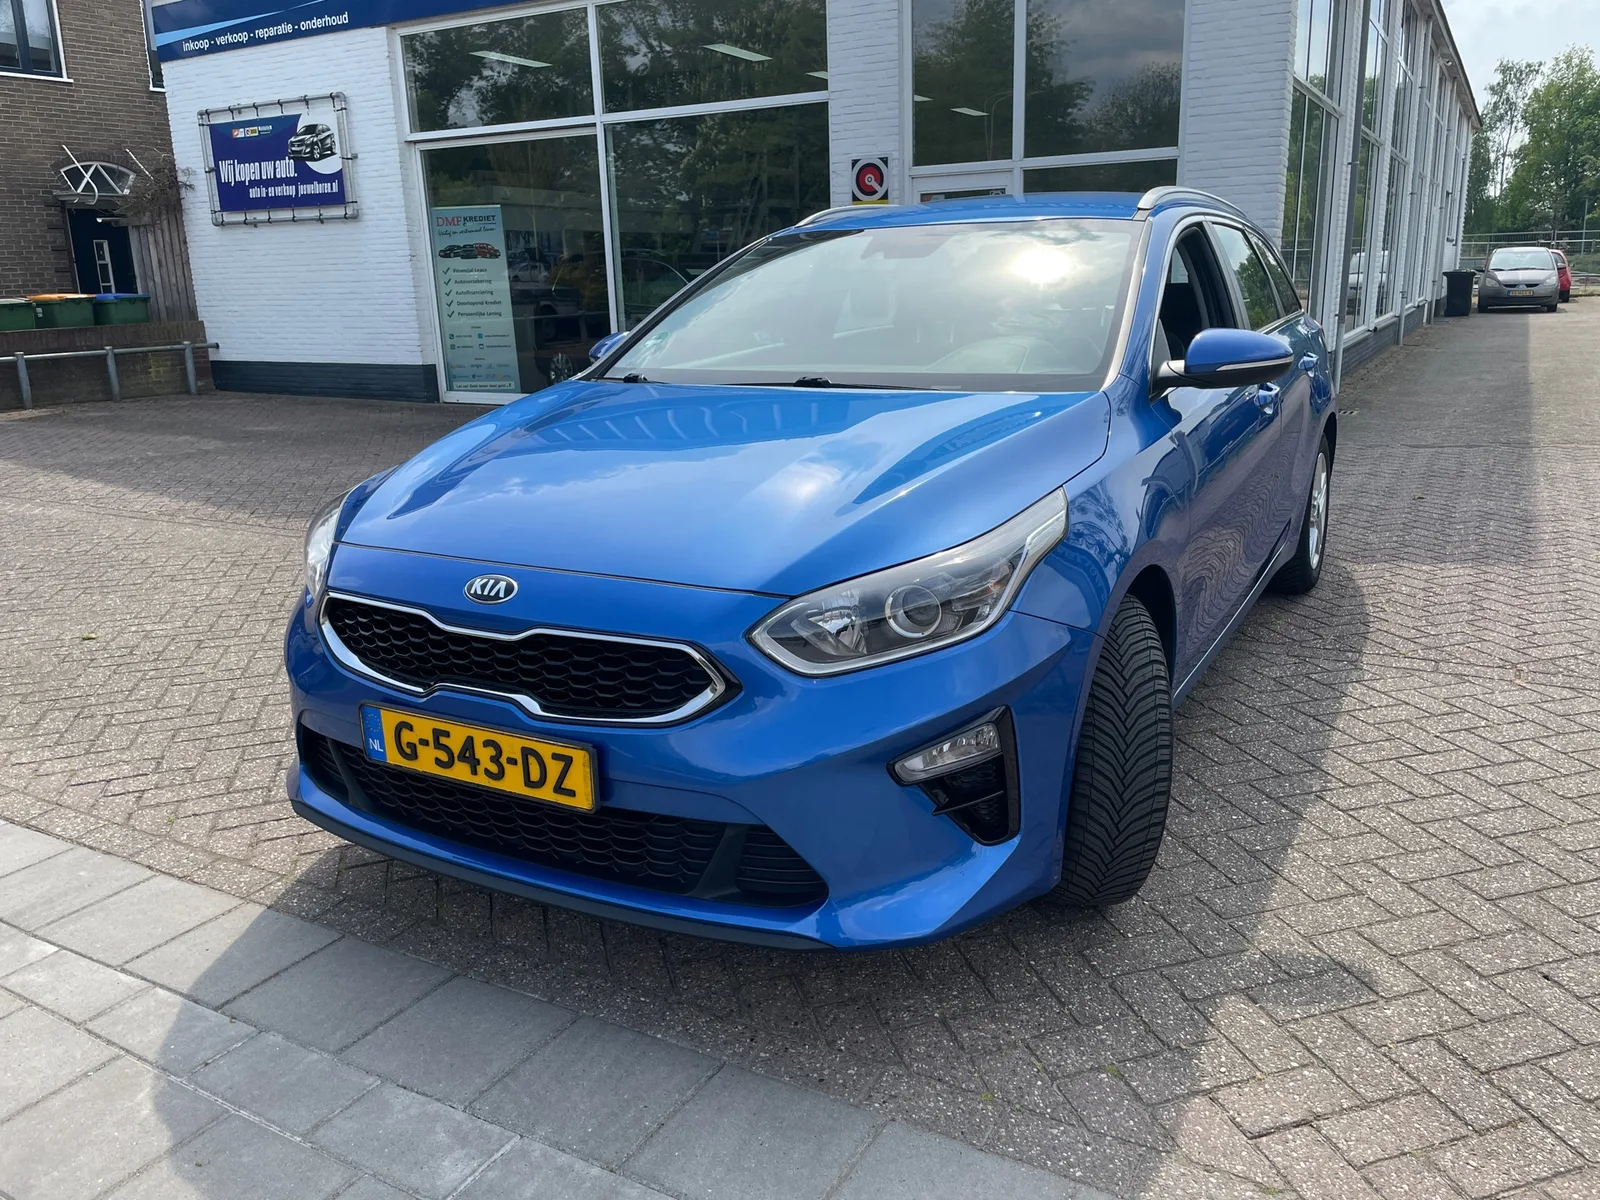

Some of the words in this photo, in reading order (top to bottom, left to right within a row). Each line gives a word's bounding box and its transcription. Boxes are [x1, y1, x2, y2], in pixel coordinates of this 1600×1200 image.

[182, 38, 209, 52] inkoop
[215, 31, 248, 46] verkoop
[255, 22, 293, 40] reparatie
[299, 11, 349, 31] onderhoud
[218, 159, 235, 187] Wij
[235, 159, 261, 186] kopen
[261, 160, 274, 180] uw
[275, 156, 298, 179] auto.
[249, 186, 260, 199] auto
[268, 187, 274, 197] en
[274, 183, 296, 199] verkoop
[436, 216, 462, 227] DMF
[463, 215, 496, 223] KREDIET
[468, 578, 506, 597] KIA
[368, 738, 384, 753] NL
[393, 721, 577, 798] G-543-DZ
